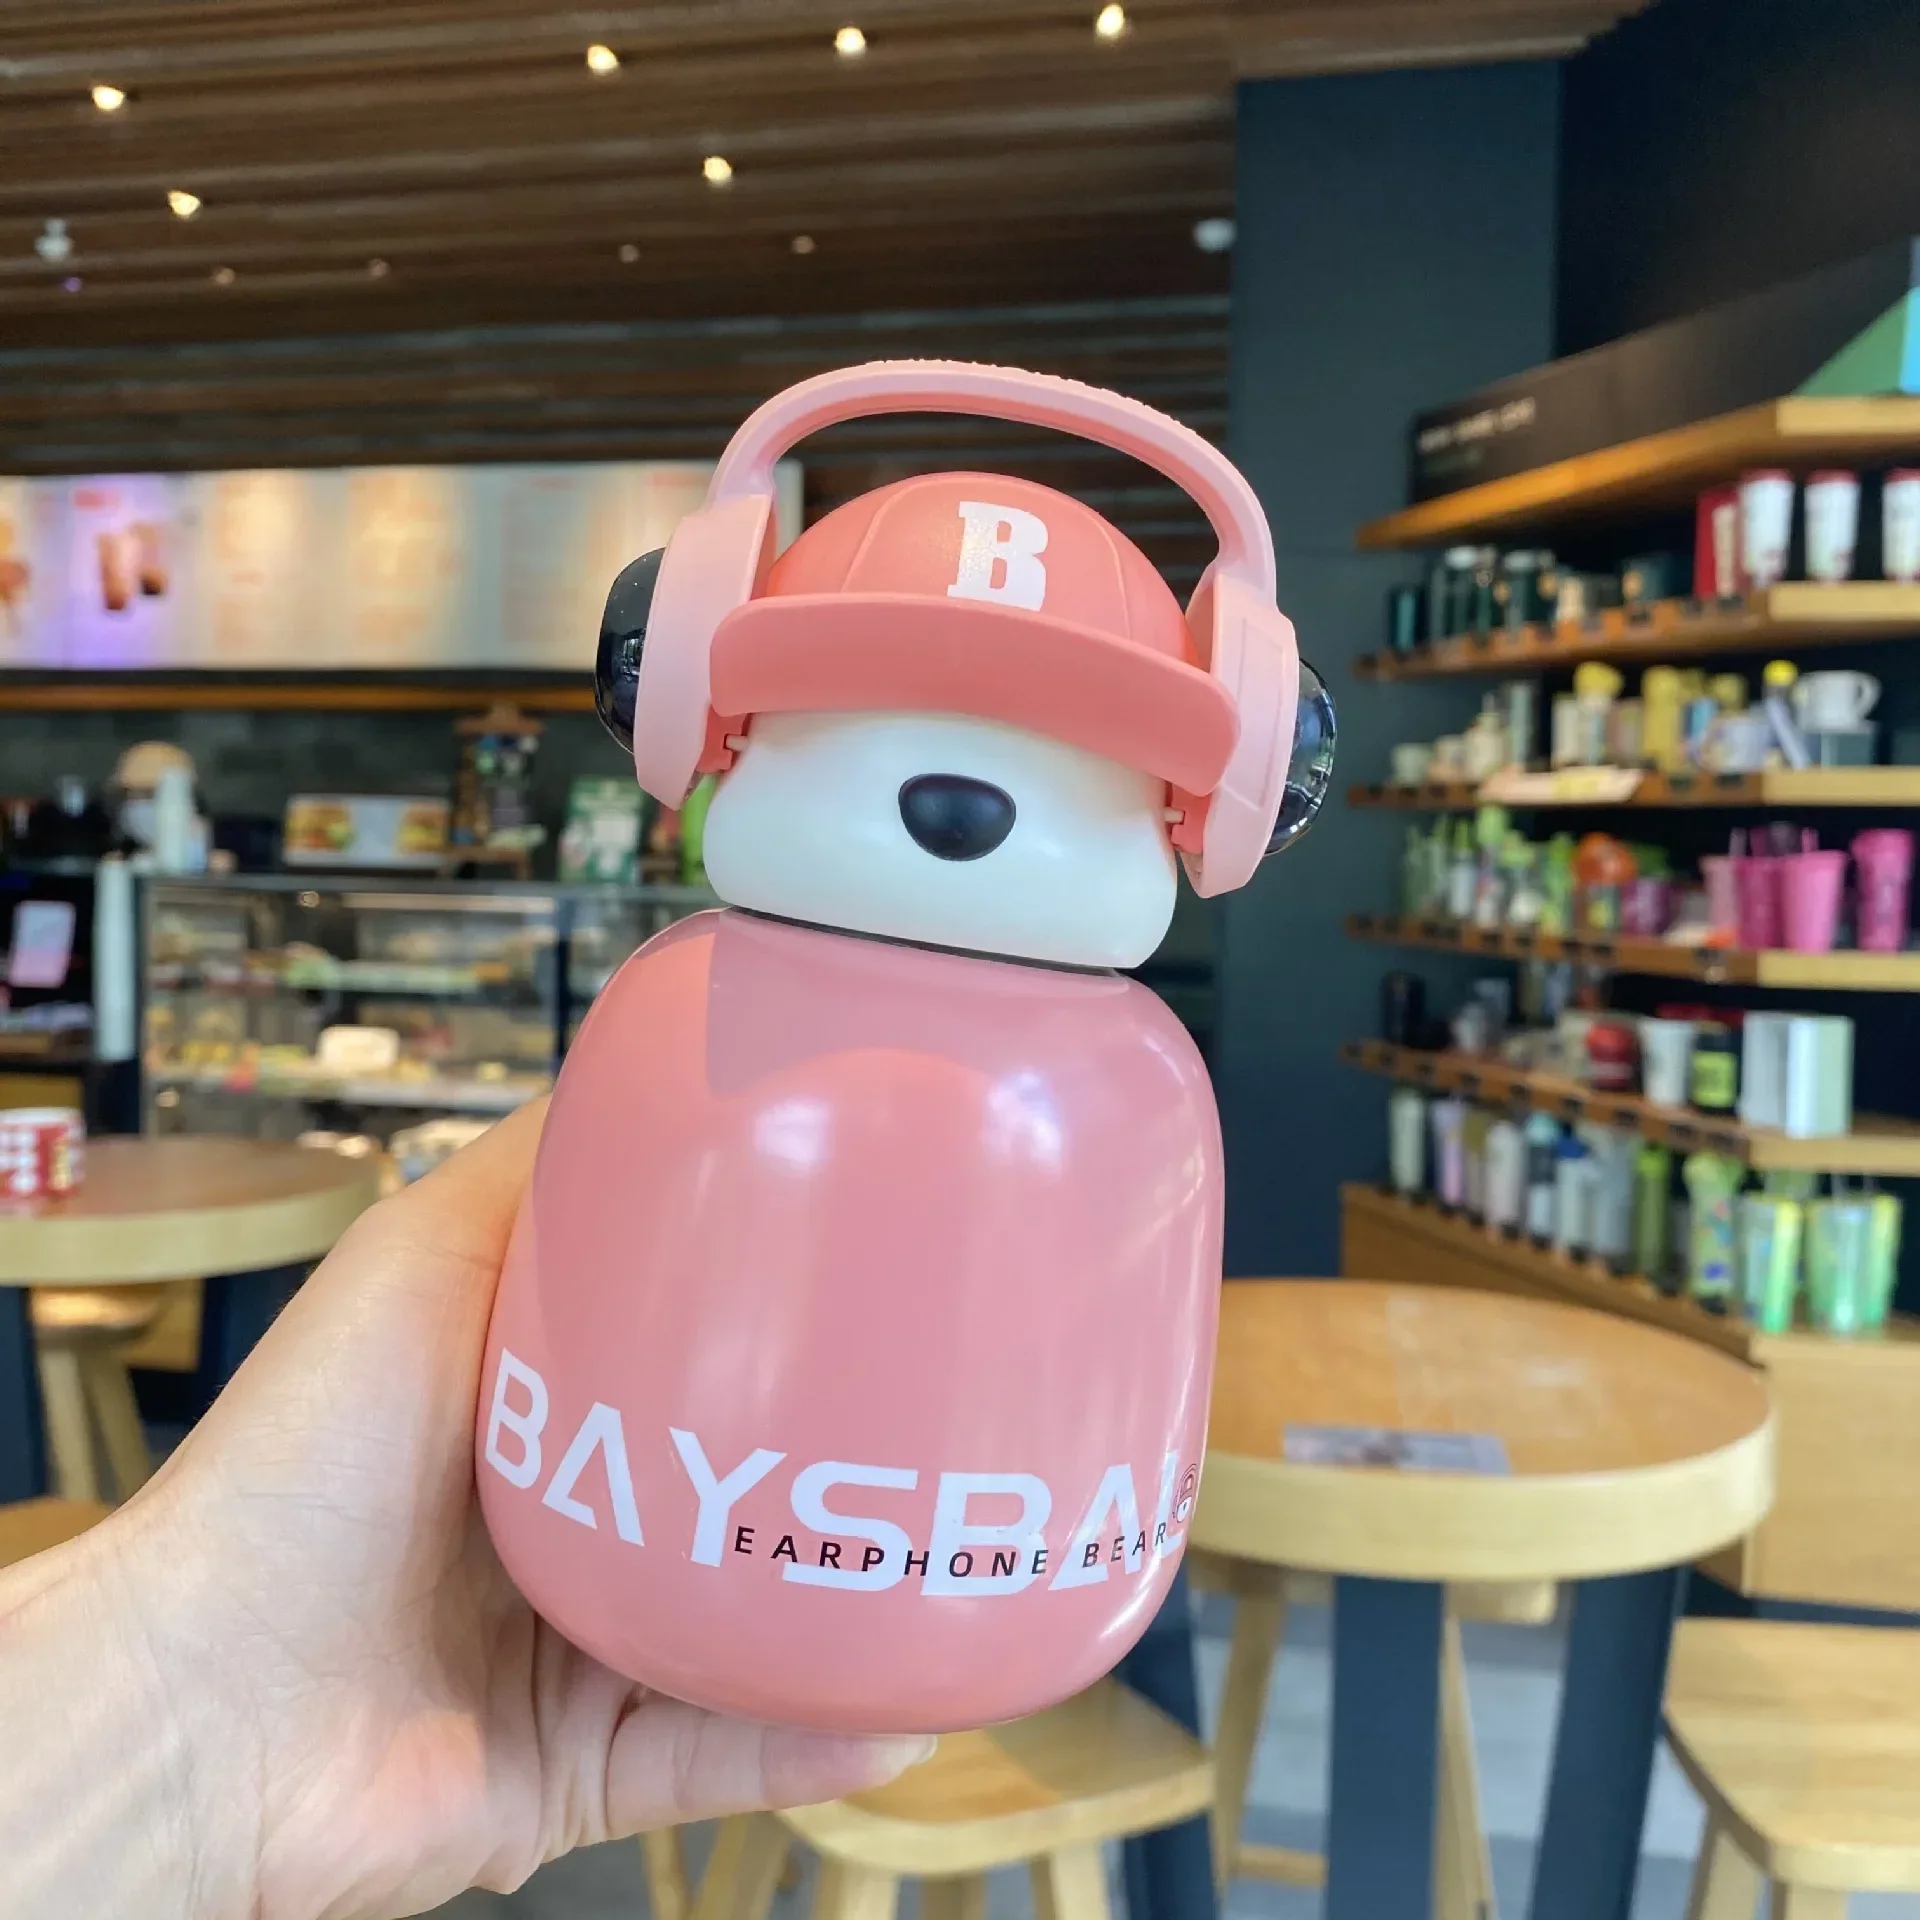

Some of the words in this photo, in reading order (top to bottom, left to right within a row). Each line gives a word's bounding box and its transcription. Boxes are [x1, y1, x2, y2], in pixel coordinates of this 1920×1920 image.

[947, 501, 1048, 612] B
[734, 1526, 1049, 1578] EARPHONE
[1082, 1522, 1167, 1568] BEAR
